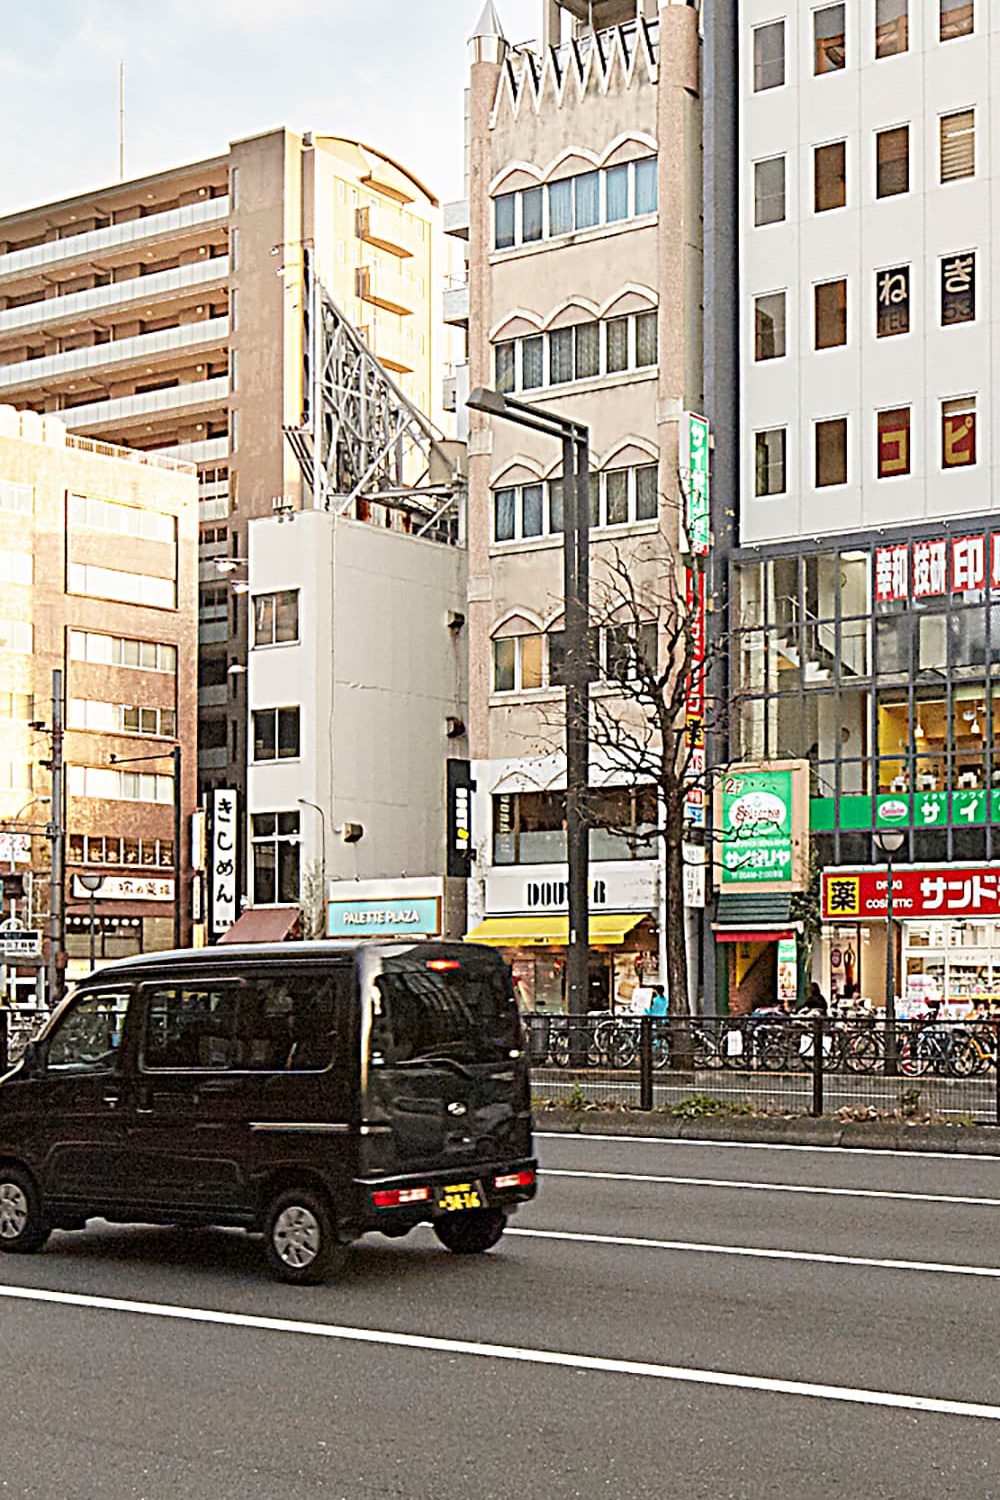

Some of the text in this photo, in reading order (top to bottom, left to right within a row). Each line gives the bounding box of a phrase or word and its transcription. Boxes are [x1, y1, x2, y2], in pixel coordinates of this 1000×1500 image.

[215, 798, 234, 904] きしめん
[830, 879, 857, 911] 薬
[343, 909, 420, 925] PALETTE PLAZA
